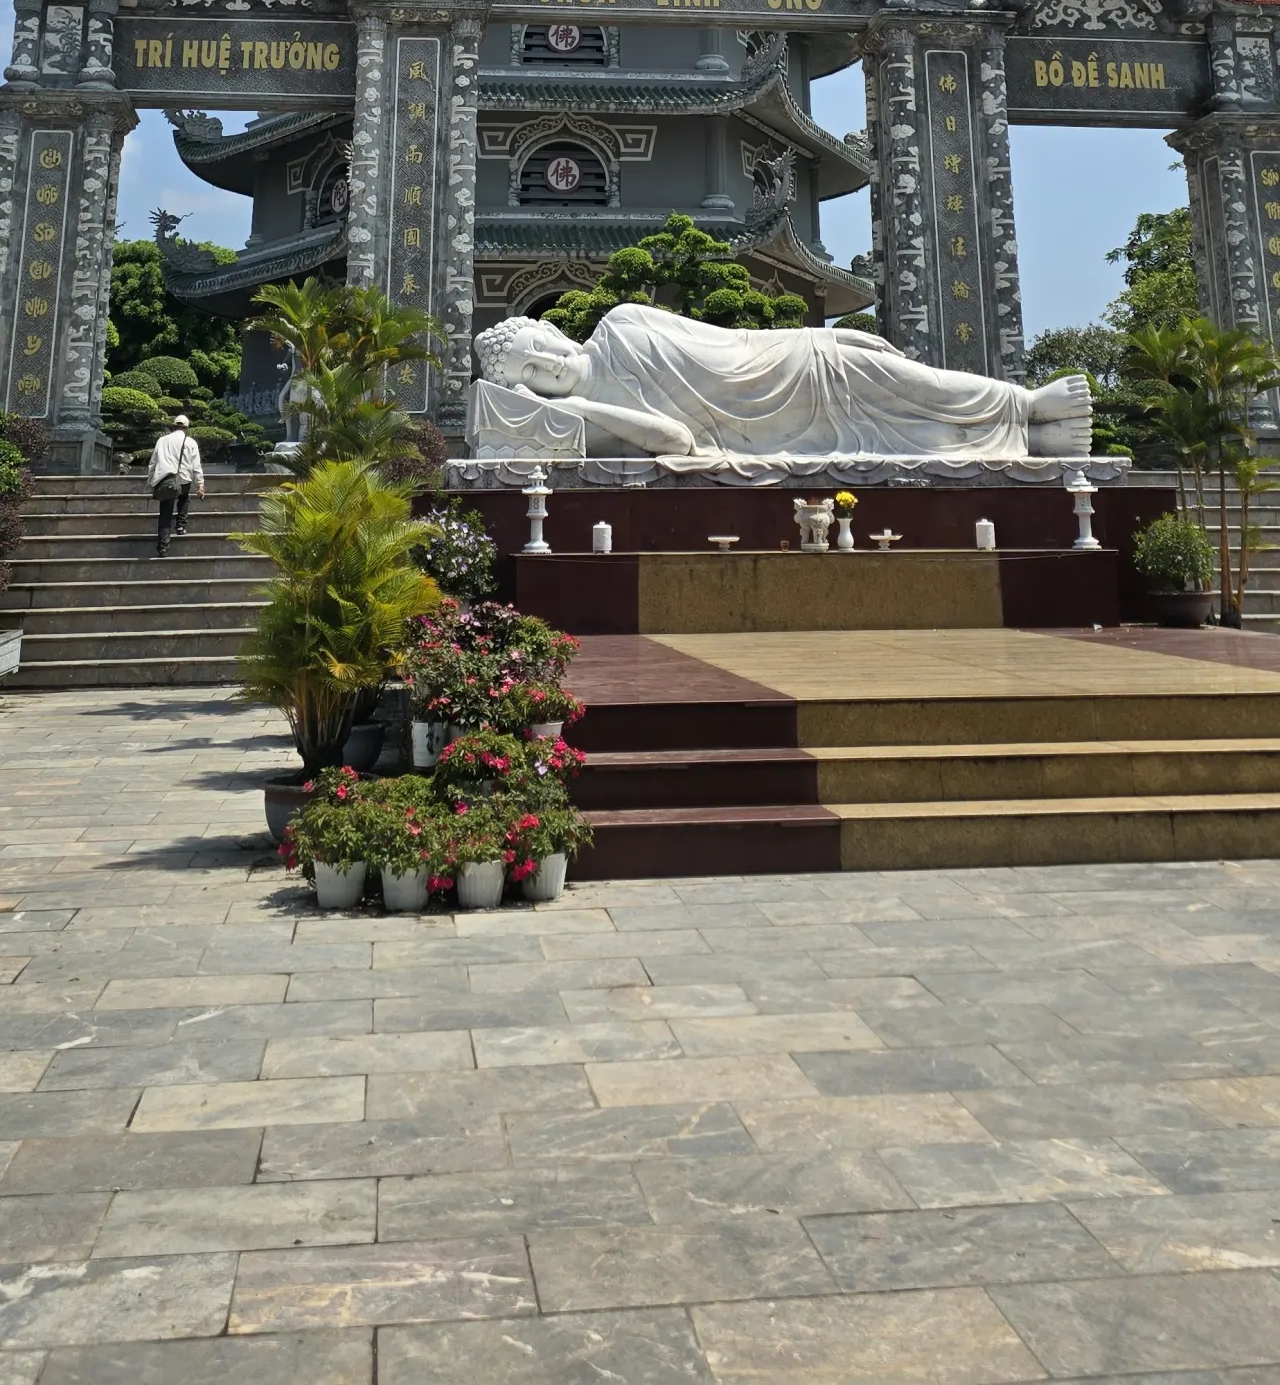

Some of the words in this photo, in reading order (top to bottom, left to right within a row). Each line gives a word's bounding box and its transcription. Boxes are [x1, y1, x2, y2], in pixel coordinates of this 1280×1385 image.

[134, 32, 174, 68] TRÍ
[182, 33, 232, 75] HUỆ
[240, 30, 340, 71] TRƯỞNG
[550, 23, 577, 49] 佛
[1035, 50, 1064, 87] BỒ
[1071, 51, 1100, 88] ĐỀ
[1106, 62, 1166, 90] SANH
[550, 160, 577, 187] 佛
[397, 61, 427, 386] 風調雨順國泰安
[938, 74, 974, 374] 佛日增輝法輪常
